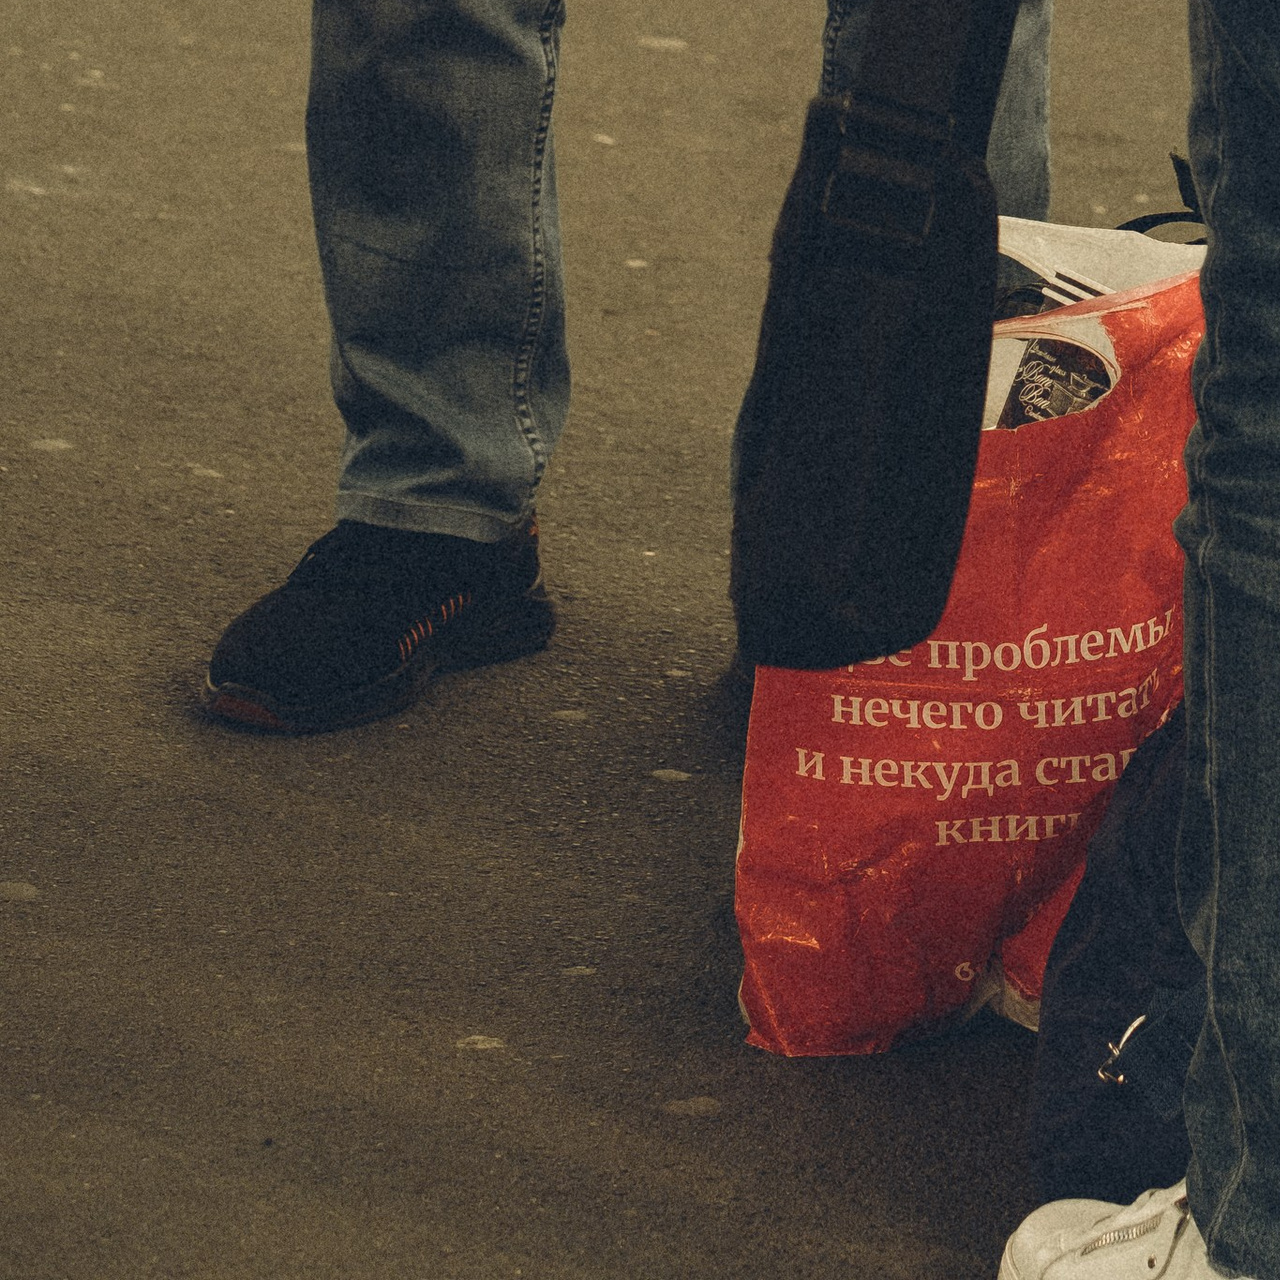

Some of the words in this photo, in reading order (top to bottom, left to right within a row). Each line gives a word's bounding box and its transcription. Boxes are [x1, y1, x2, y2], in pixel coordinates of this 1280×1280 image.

[927, 608, 1174, 681] проблемы
[831, 693, 1003, 730] нечего
[795, 747, 826, 781] и
[839, 754, 1021, 801] некуда
